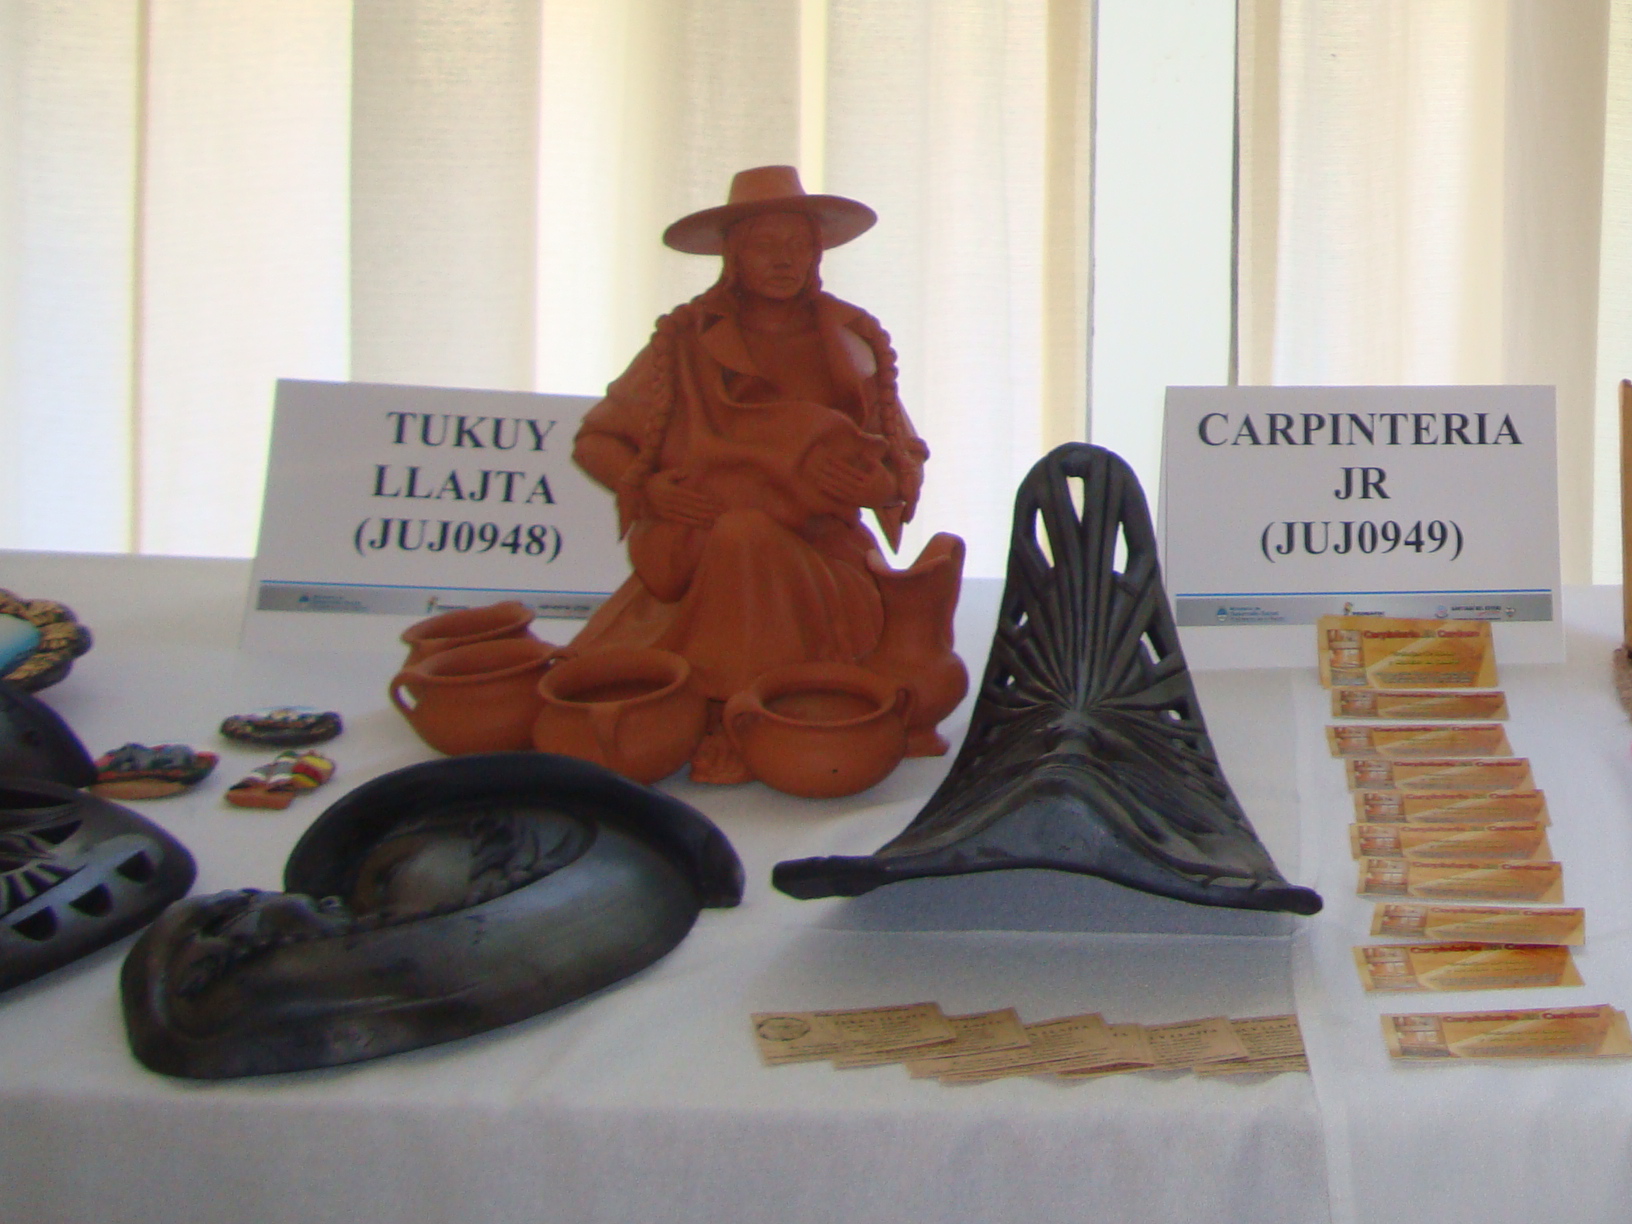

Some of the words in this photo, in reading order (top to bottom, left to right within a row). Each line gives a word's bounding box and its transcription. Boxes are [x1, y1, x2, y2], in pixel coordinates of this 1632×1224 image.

[386, 410, 558, 452] TUKUY
[1198, 412, 1524, 447] CARPINTERIA
[371, 463, 557, 505] LLAJTA
[1333, 466, 1392, 500] JR
[353, 517, 564, 564] (JUJ0948)
[1261, 519, 1465, 563] (JUJ0949)
